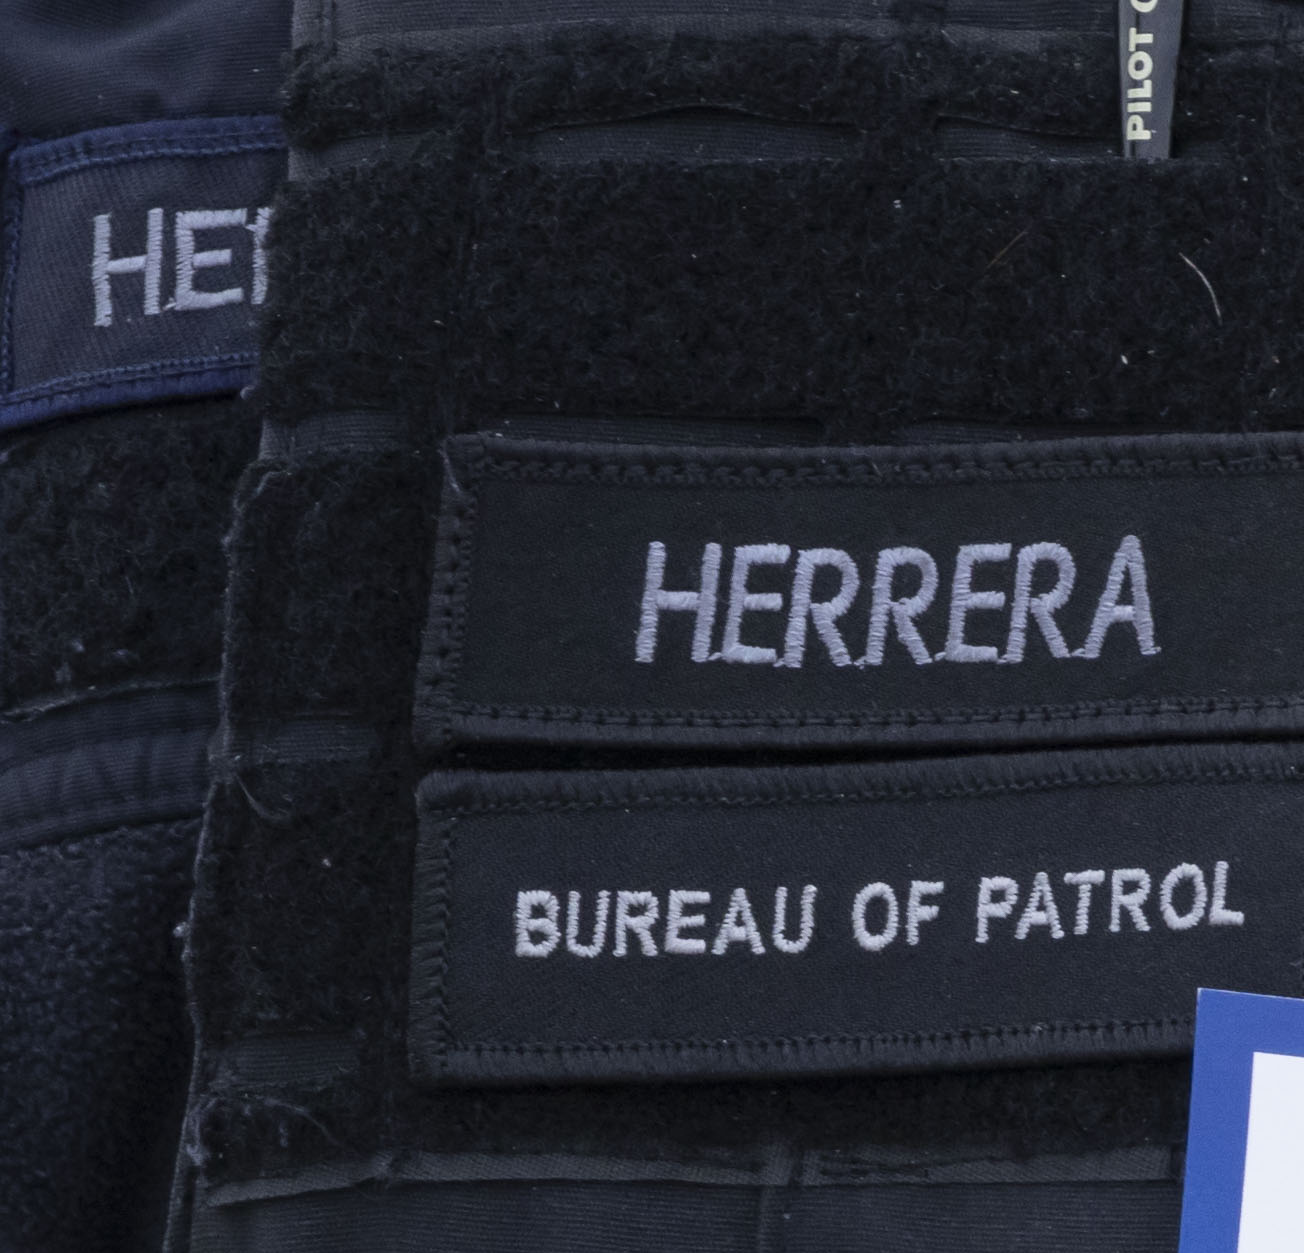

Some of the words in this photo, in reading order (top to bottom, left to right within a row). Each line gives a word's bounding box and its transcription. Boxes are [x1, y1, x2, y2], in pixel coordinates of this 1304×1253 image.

[1127, 27, 1154, 140] PILOT
[634, 535, 1161, 668] HERRERA
[514, 884, 818, 957] BUREAU
[851, 881, 944, 952] OF
[975, 860, 1245, 943] PATROL
